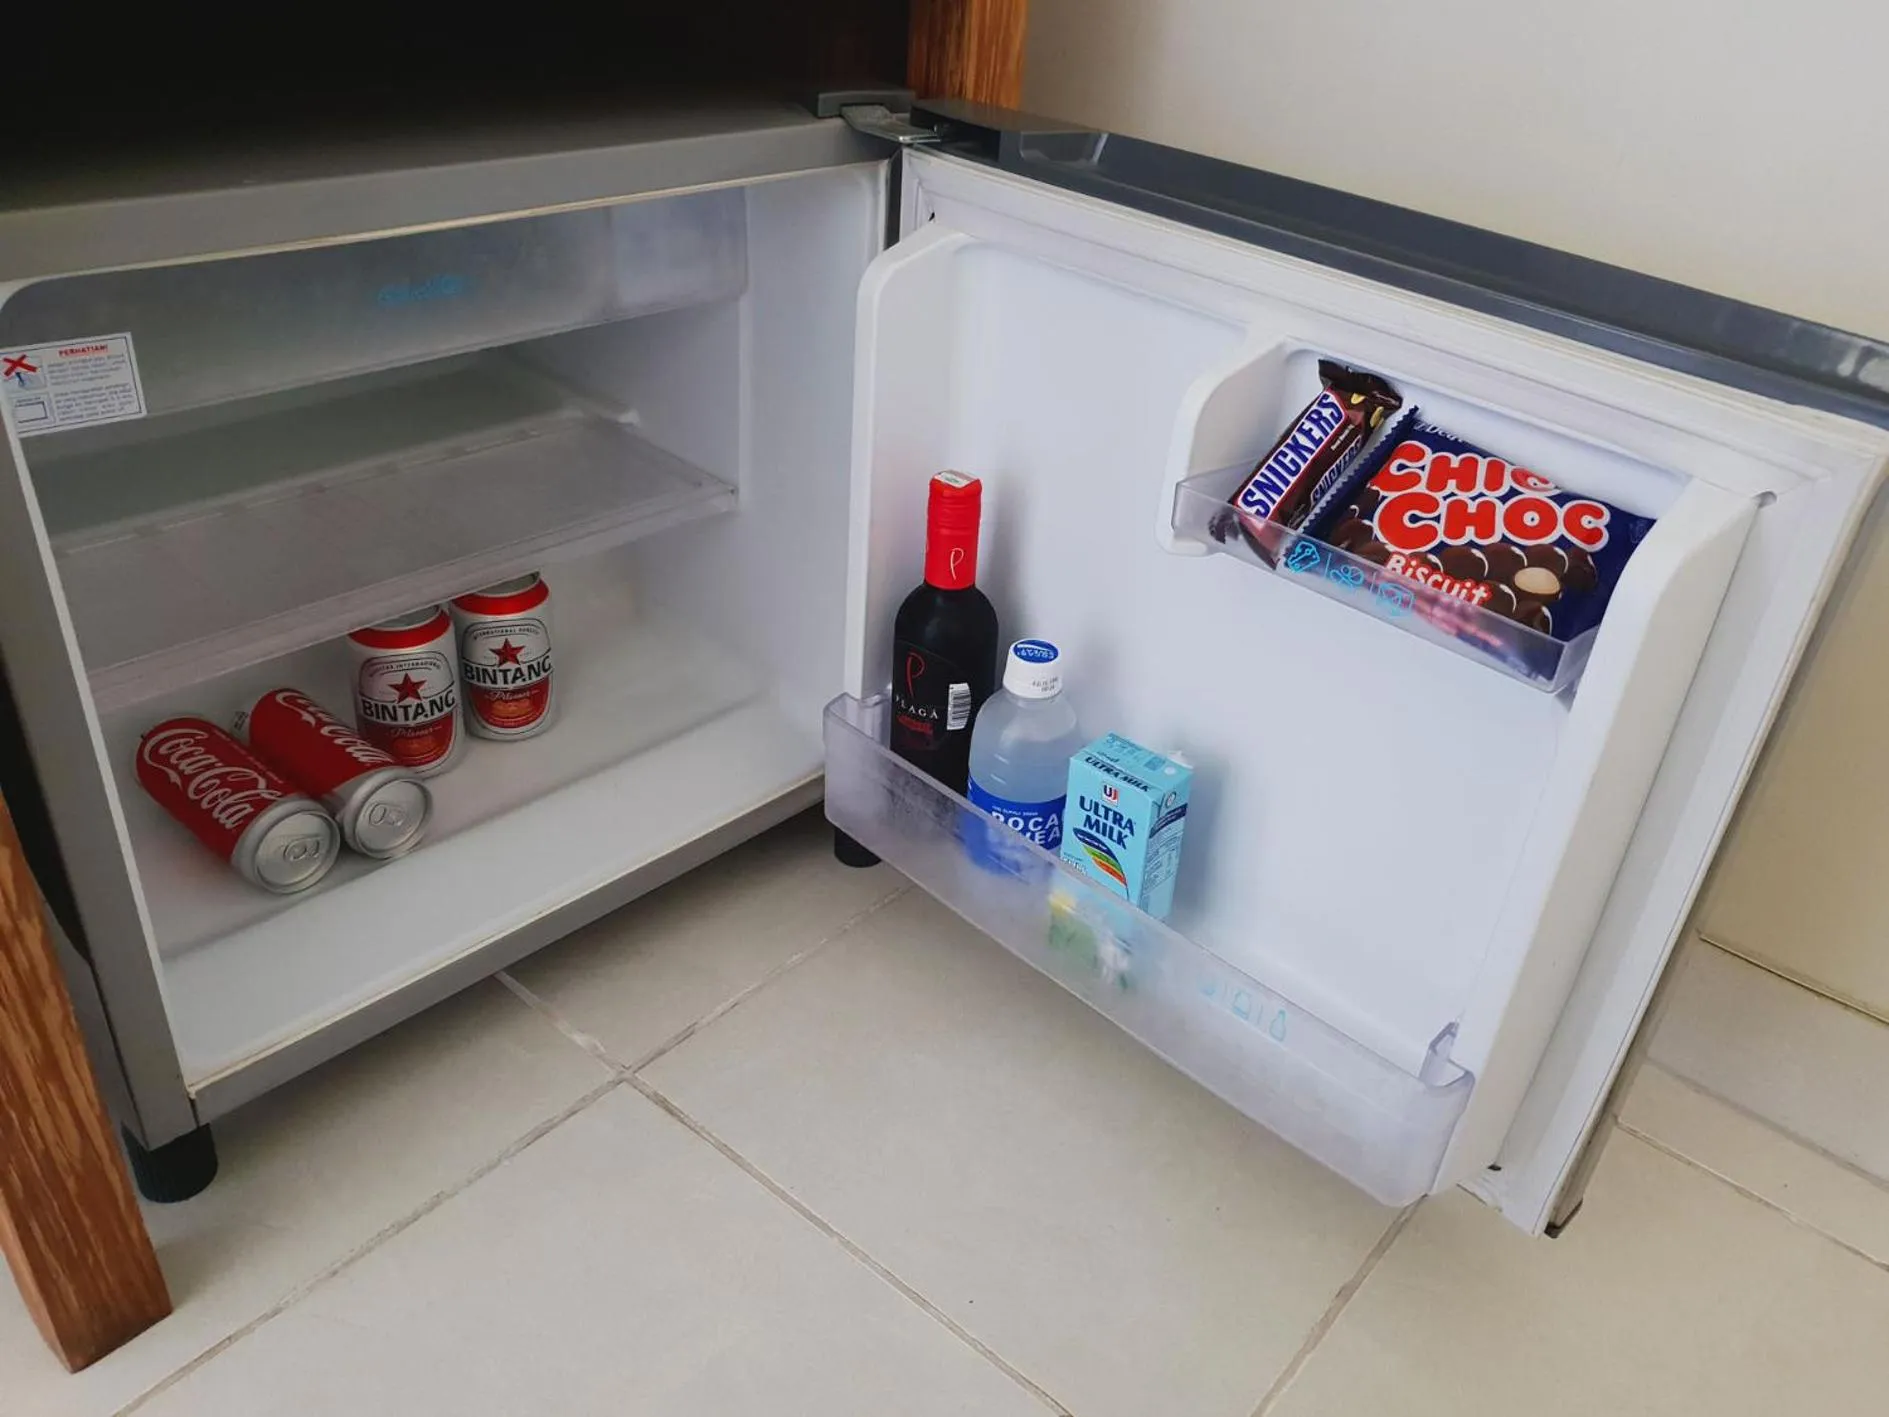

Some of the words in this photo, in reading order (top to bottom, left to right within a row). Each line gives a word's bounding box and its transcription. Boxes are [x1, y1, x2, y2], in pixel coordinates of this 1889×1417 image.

[1239, 392, 1345, 520] SNICKERS
[1374, 491, 1610, 552] CHOC
[1386, 553, 1490, 607] Biscuit
[462, 655, 551, 685] BINTANG
[361, 689, 456, 722] BINTANG
[1084, 756, 1120, 779] ULTRA
[1078, 794, 1136, 837] ULTRA
[1083, 814, 1128, 850] MILK
